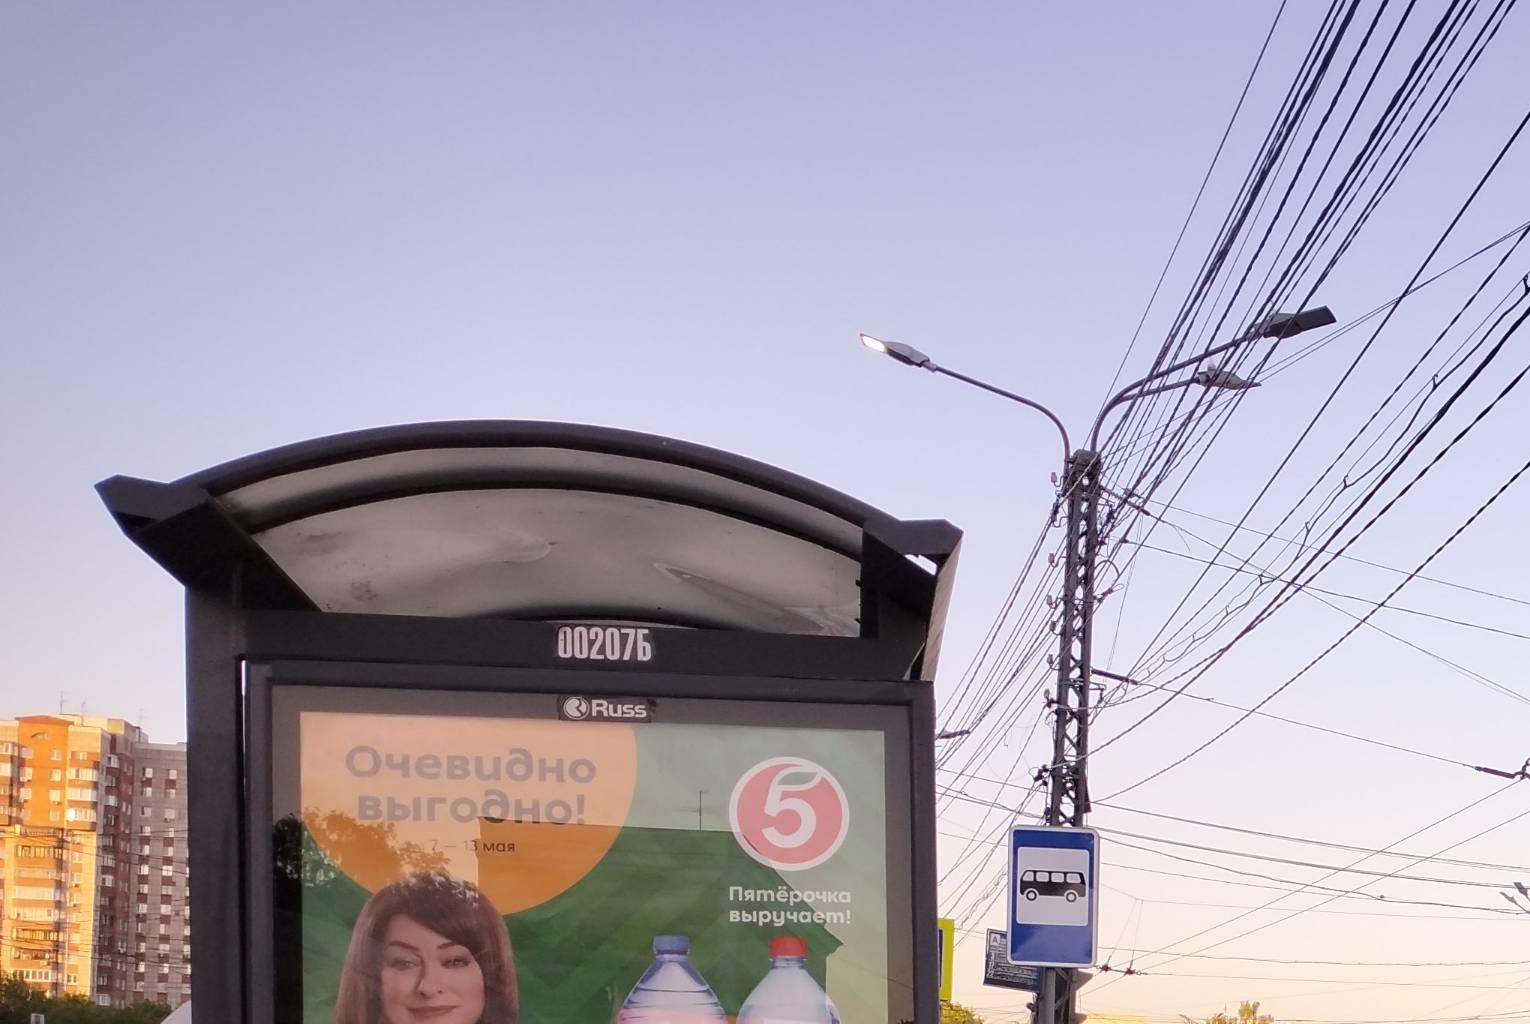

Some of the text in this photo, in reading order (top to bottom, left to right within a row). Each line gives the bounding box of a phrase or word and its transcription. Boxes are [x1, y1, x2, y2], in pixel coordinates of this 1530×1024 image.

[591, 700, 647, 718] Russ
[345, 745, 598, 784] Очевидно
[357, 789, 585, 826] выгодно!
[761, 766, 824, 848] 5
[483, 842, 516, 853] мая
[729, 886, 851, 905] Пятёрочка
[729, 909, 851, 927] выручает!
